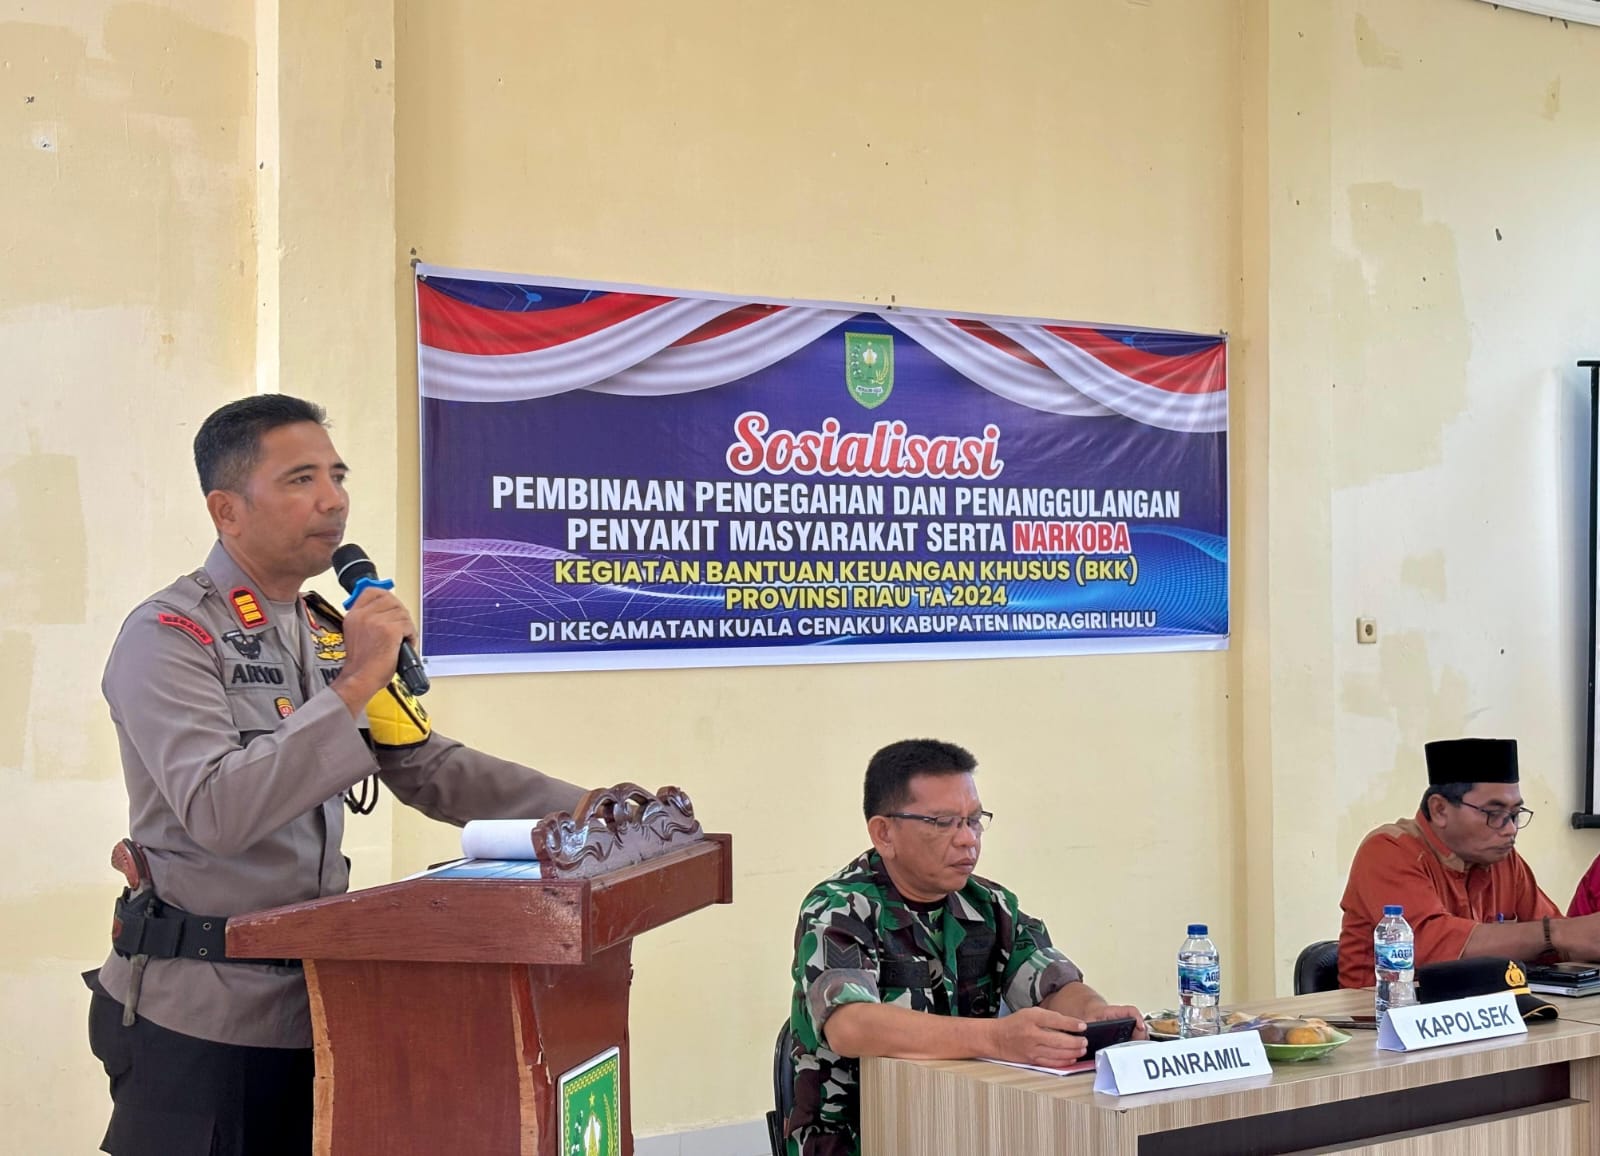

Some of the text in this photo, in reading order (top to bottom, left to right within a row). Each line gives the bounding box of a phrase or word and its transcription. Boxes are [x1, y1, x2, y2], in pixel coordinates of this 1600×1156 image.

[726, 411, 1005, 480] Sosialisasi
[492, 475, 1181, 519] PEMBINAAN PENCEGAHAN DAN PENANGGULANGAN
[567, 517, 1132, 555] PENYAKIT MASYARAKAT SERTA NARKOBA
[554, 555, 1139, 586] KEGIATAN BANTUAN KEUANGAN KHUSUS (BKK)
[725, 585, 1007, 611] PROVINSI RIAU TA 2024
[529, 611, 1157, 643] DI KECAMATAN KUALA CENAKU KABUPATEN INDRAGIRI HULU
[1416, 1004, 1515, 1041] KAPOLSEK
[1144, 1046, 1250, 1080] DANRAMIL
